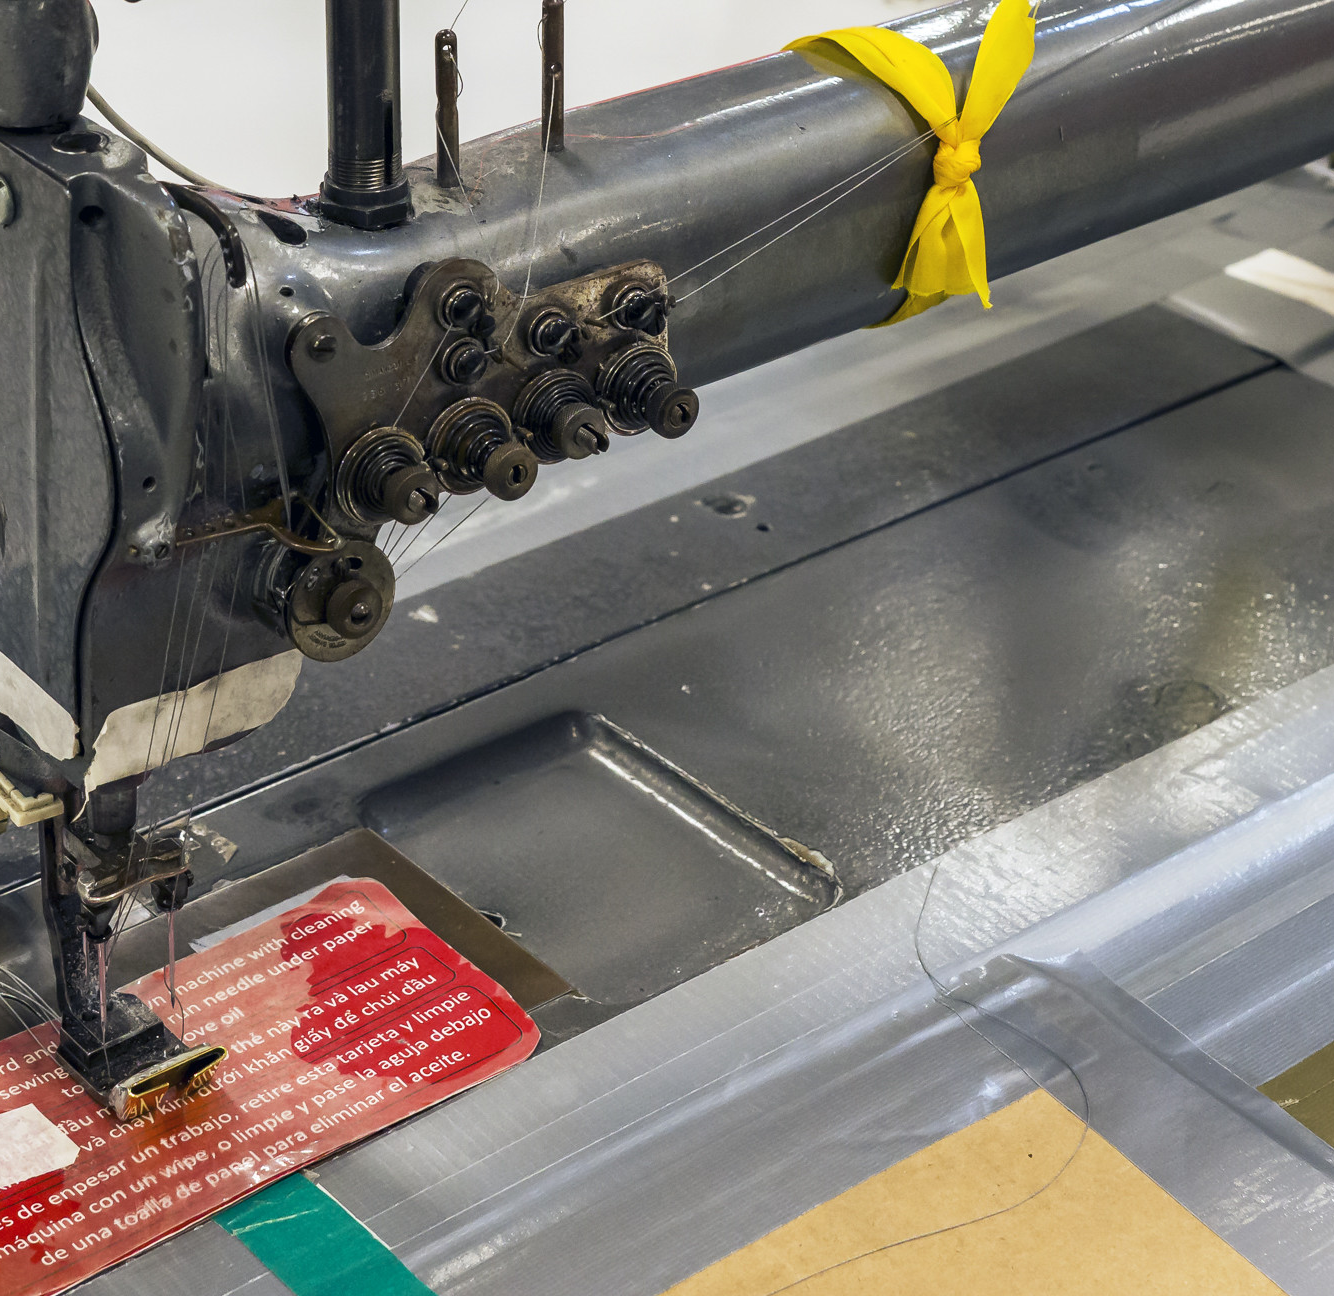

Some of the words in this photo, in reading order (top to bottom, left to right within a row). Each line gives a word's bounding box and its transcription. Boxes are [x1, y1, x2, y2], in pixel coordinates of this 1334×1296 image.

[0, 1065, 69, 1100] sewing
[167, 1003, 202, 1024] run
[203, 973, 266, 1007] needle
[267, 945, 321, 976] under
[322, 919, 375, 953] paper
[23, 1041, 58, 1064] and
[247, 938, 289, 961] with
[290, 899, 366, 941] cleaning
[61, 1084, 85, 1098] to
[220, 1006, 245, 1024] oil
[267, 1014, 301, 1038] này
[303, 1005, 324, 1019] ra
[324, 992, 349, 1008] và
[347, 977, 380, 996] lau
[380, 957, 419, 981] máy
[17, 1200, 45, 1220] de
[48, 1158, 127, 1206] enpesar
[131, 1144, 159, 1164] un
[163, 1111, 239, 1151] trabajo,
[239, 1082, 294, 1113] retire
[296, 1062, 336, 1085] esta
[336, 1029, 400, 1064] tarjeta
[399, 1020, 413, 1032] y
[411, 990, 472, 1024] limpie
[41, 1249, 69, 1267] de
[72, 1226, 113, 1252] una
[113, 1195, 173, 1231] toalla
[176, 1180, 203, 1200] de
[205, 1151, 262, 1187] papel
[262, 1130, 308, 1164] para
[310, 1090, 385, 1134] eliminar
[388, 1076, 408, 1093] el
[408, 1050, 471, 1083] aceite.
[80, 1135, 107, 1152] và
[109, 1111, 155, 1139] chạy
[89, 1190, 128, 1214] con
[129, 1172, 158, 1192] un
[159, 1149, 216, 1179] wipe,
[218, 1140, 232, 1151] o
[231, 1108, 295, 1144] limpie
[295, 1101, 309, 1115] y
[311, 1079, 357, 1108] pase
[355, 1068, 377, 1081] la
[378, 1040, 429, 1070] aguja
[430, 1006, 492, 1043] debajo
